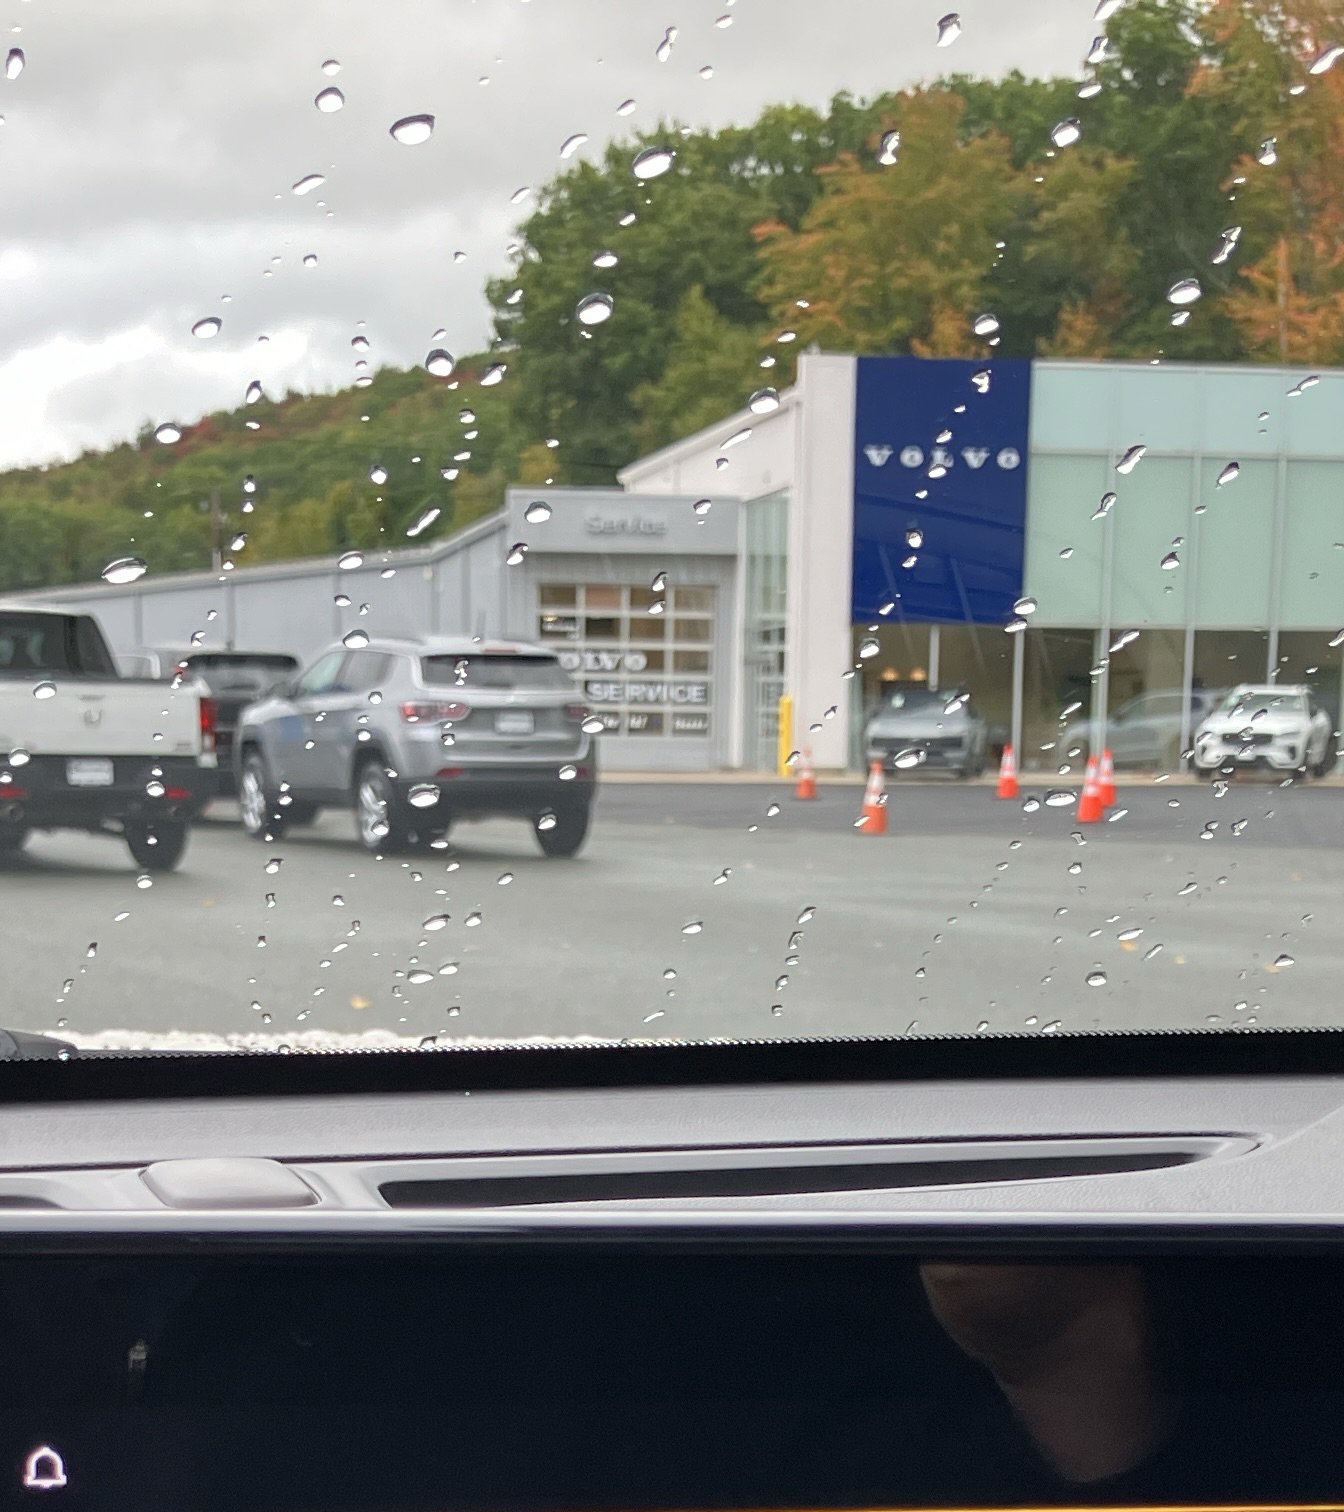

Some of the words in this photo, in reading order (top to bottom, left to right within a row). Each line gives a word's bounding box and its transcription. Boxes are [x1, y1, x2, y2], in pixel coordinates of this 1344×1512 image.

[862, 444, 1021, 470] VOLVO
[558, 651, 647, 672] OLVO
[586, 684, 707, 702] SERVICE
